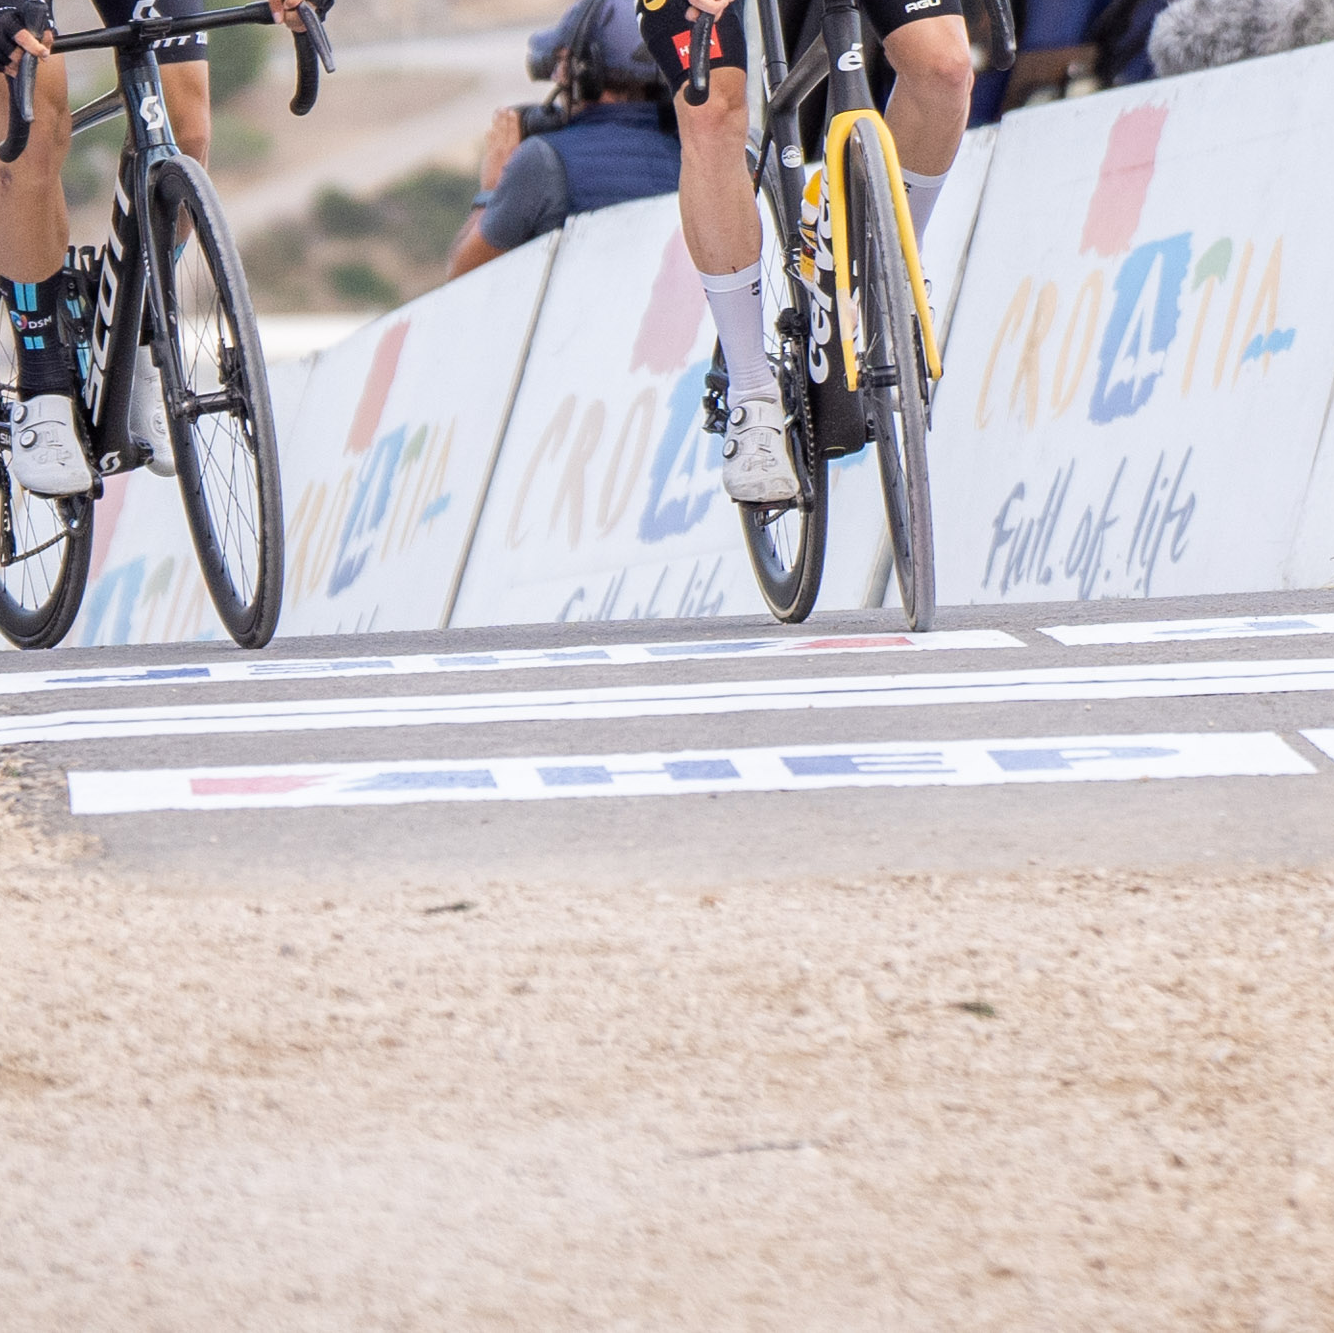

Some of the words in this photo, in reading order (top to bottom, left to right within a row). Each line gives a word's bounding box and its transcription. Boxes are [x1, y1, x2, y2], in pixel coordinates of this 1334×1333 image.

[28, 317, 52, 329] DSM
[85, 176, 130, 427] SCOTT
[975, 232, 1296, 430] CROATIA
[981, 456, 1075, 597] Full
[1064, 456, 1128, 600] of
[1126, 445, 1196, 598] life
